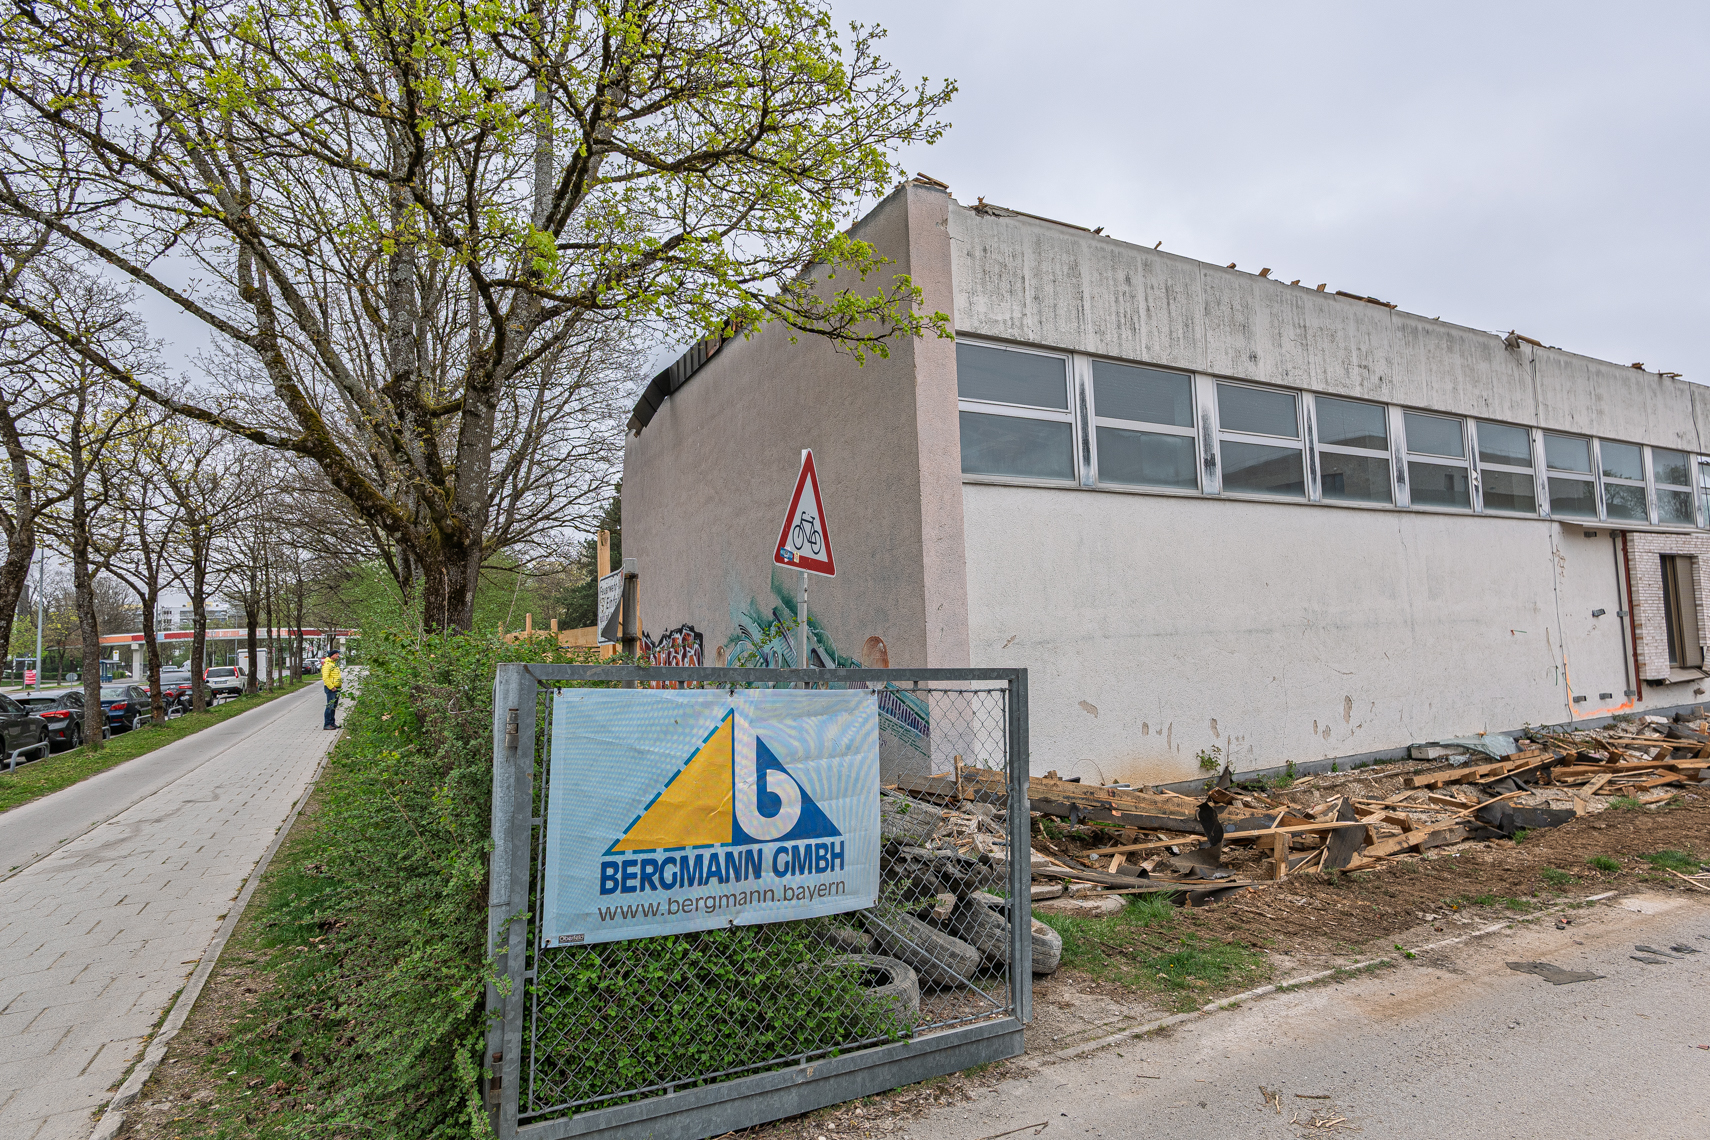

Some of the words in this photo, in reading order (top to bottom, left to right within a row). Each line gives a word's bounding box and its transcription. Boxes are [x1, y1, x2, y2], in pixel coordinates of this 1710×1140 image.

[599, 847, 763, 896] BERGMANN
[771, 840, 845, 879] GMBH
[597, 880, 846, 922] www.bergmann.bayern
